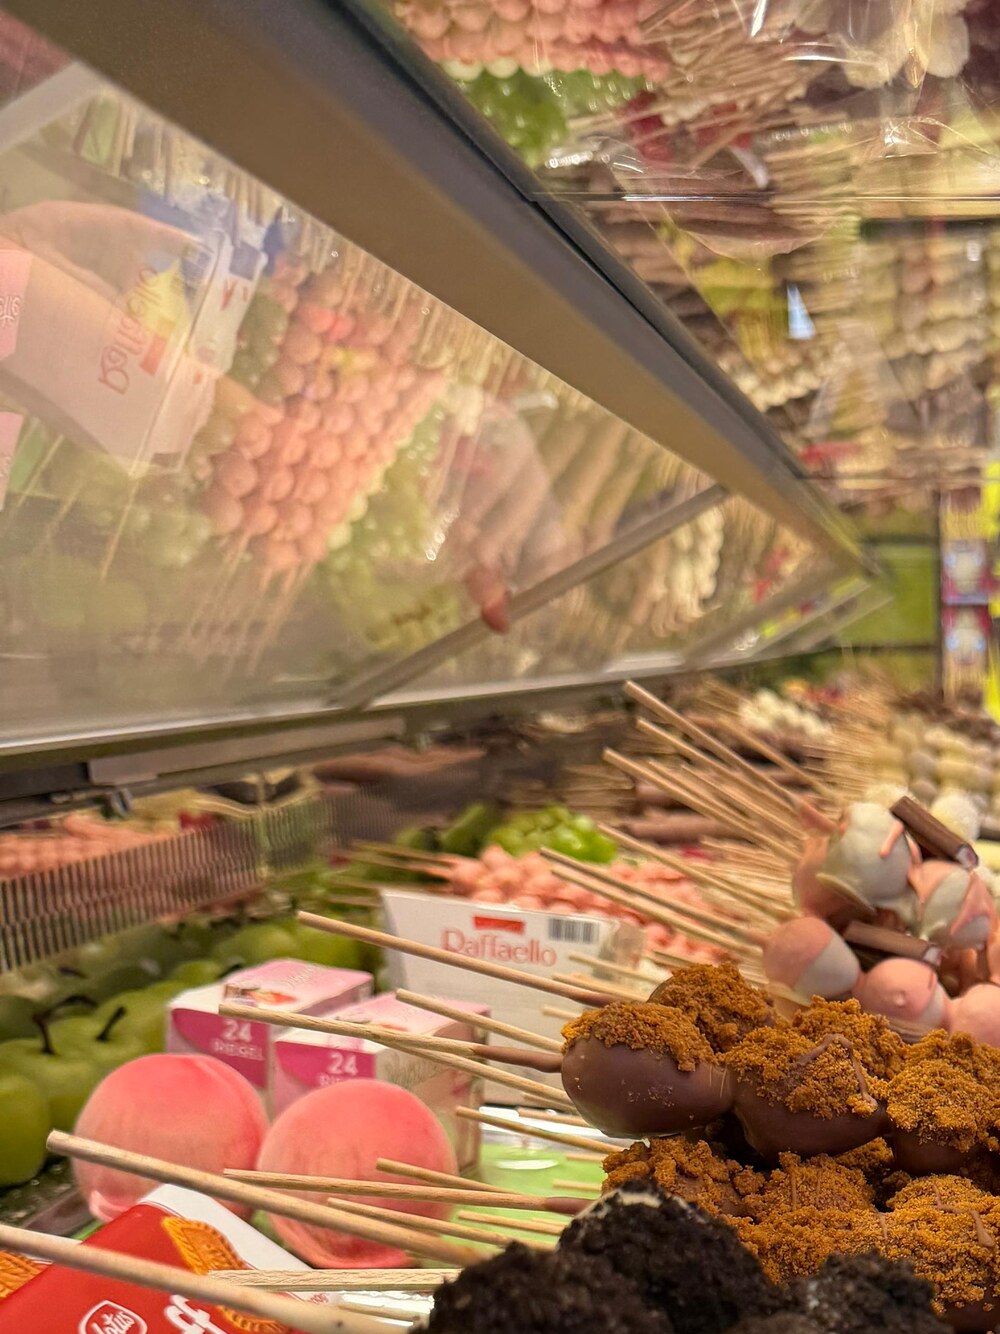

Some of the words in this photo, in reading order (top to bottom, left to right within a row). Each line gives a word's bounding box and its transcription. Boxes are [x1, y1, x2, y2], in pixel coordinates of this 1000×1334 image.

[441, 927, 557, 967] Raffaello
[221, 1018, 252, 1042] 24
[328, 1051, 358, 1076] 24
